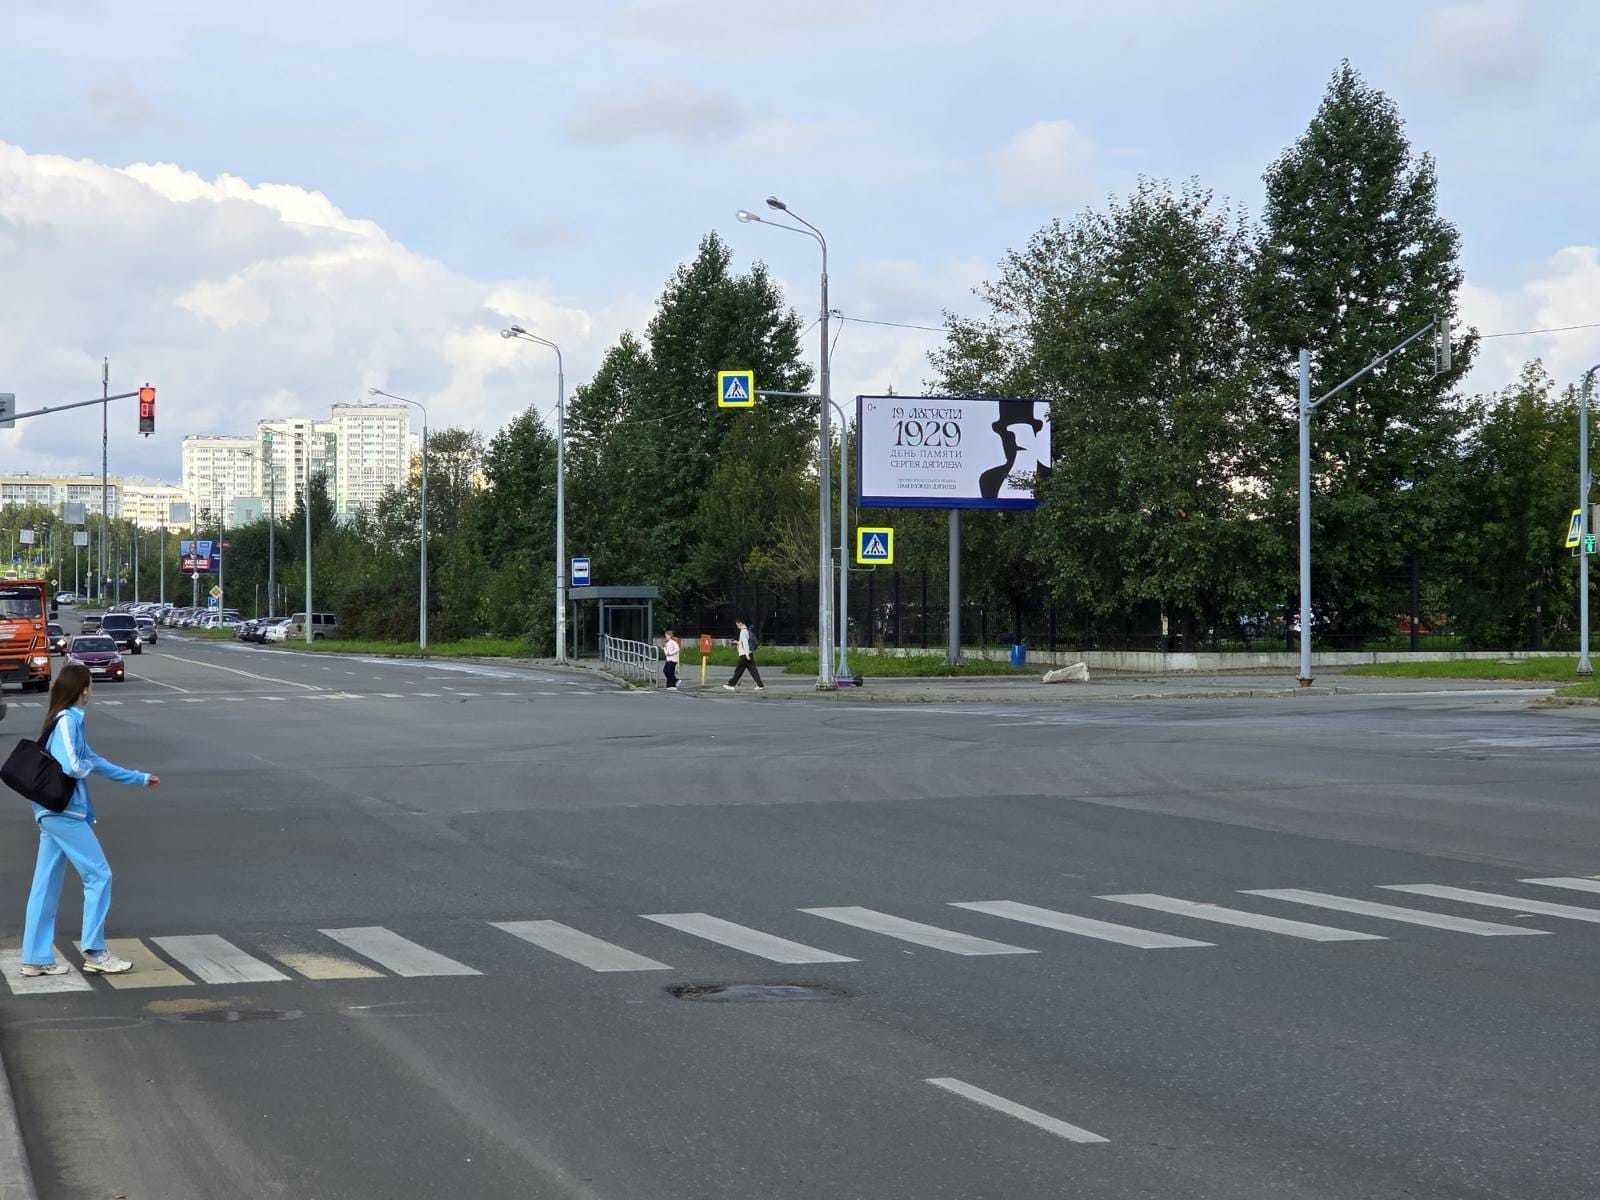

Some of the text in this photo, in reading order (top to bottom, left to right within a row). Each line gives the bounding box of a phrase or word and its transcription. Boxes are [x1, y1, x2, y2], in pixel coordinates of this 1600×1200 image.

[892, 407, 905, 419] 19
[894, 420, 961, 447] 1929
[890, 449, 962, 458] ДЕНЬ ПАМЯТИ
[890, 460, 962, 469] СЕРГЕЯ ДЯГИЛЕВА
